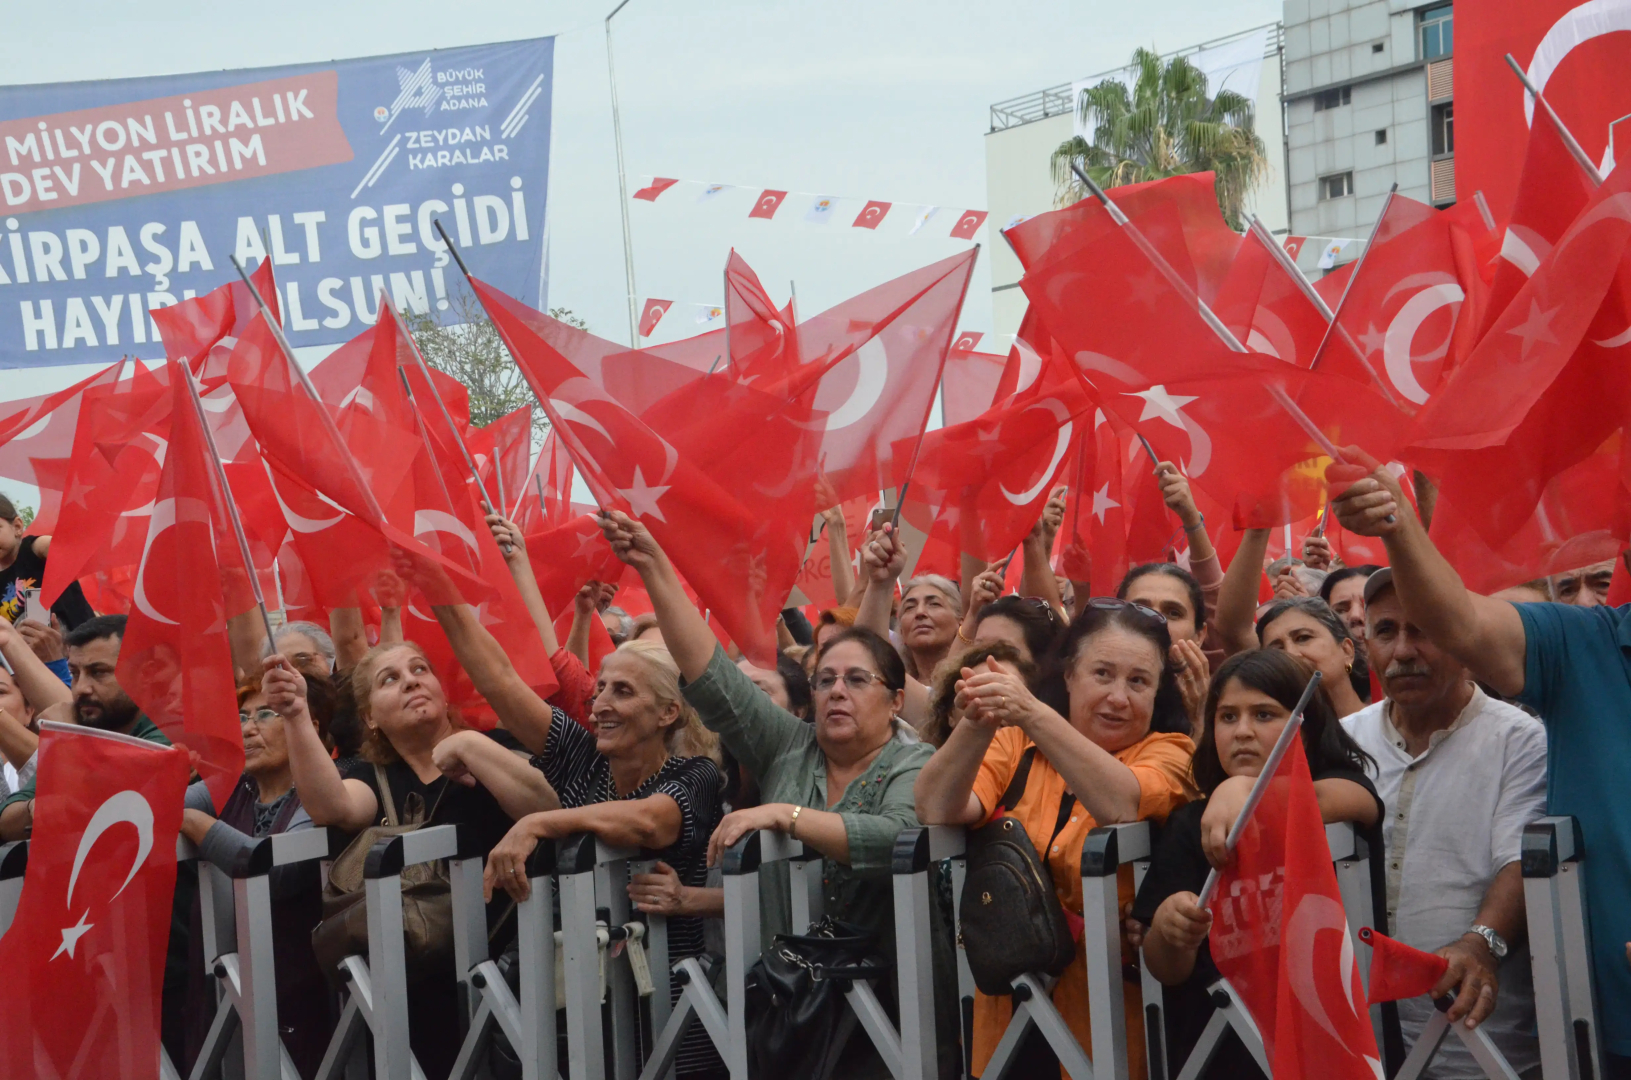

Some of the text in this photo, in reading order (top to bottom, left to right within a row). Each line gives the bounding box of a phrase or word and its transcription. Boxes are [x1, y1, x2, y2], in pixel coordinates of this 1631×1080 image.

[437, 69, 484, 83] BÜYÜK
[444, 82, 486, 100] ŞEHİR
[440, 98, 488, 111] ADANA
[4, 88, 315, 166] MİLYON LİRALIK
[404, 124, 491, 149] ZEYDAN
[0, 133, 267, 207] DEV YATIRIM
[408, 144, 509, 170] KARALAR
[0, 176, 530, 292] İRPAŞA ALT GEÇİDİ
[274, 267, 449, 333] LSUN!
